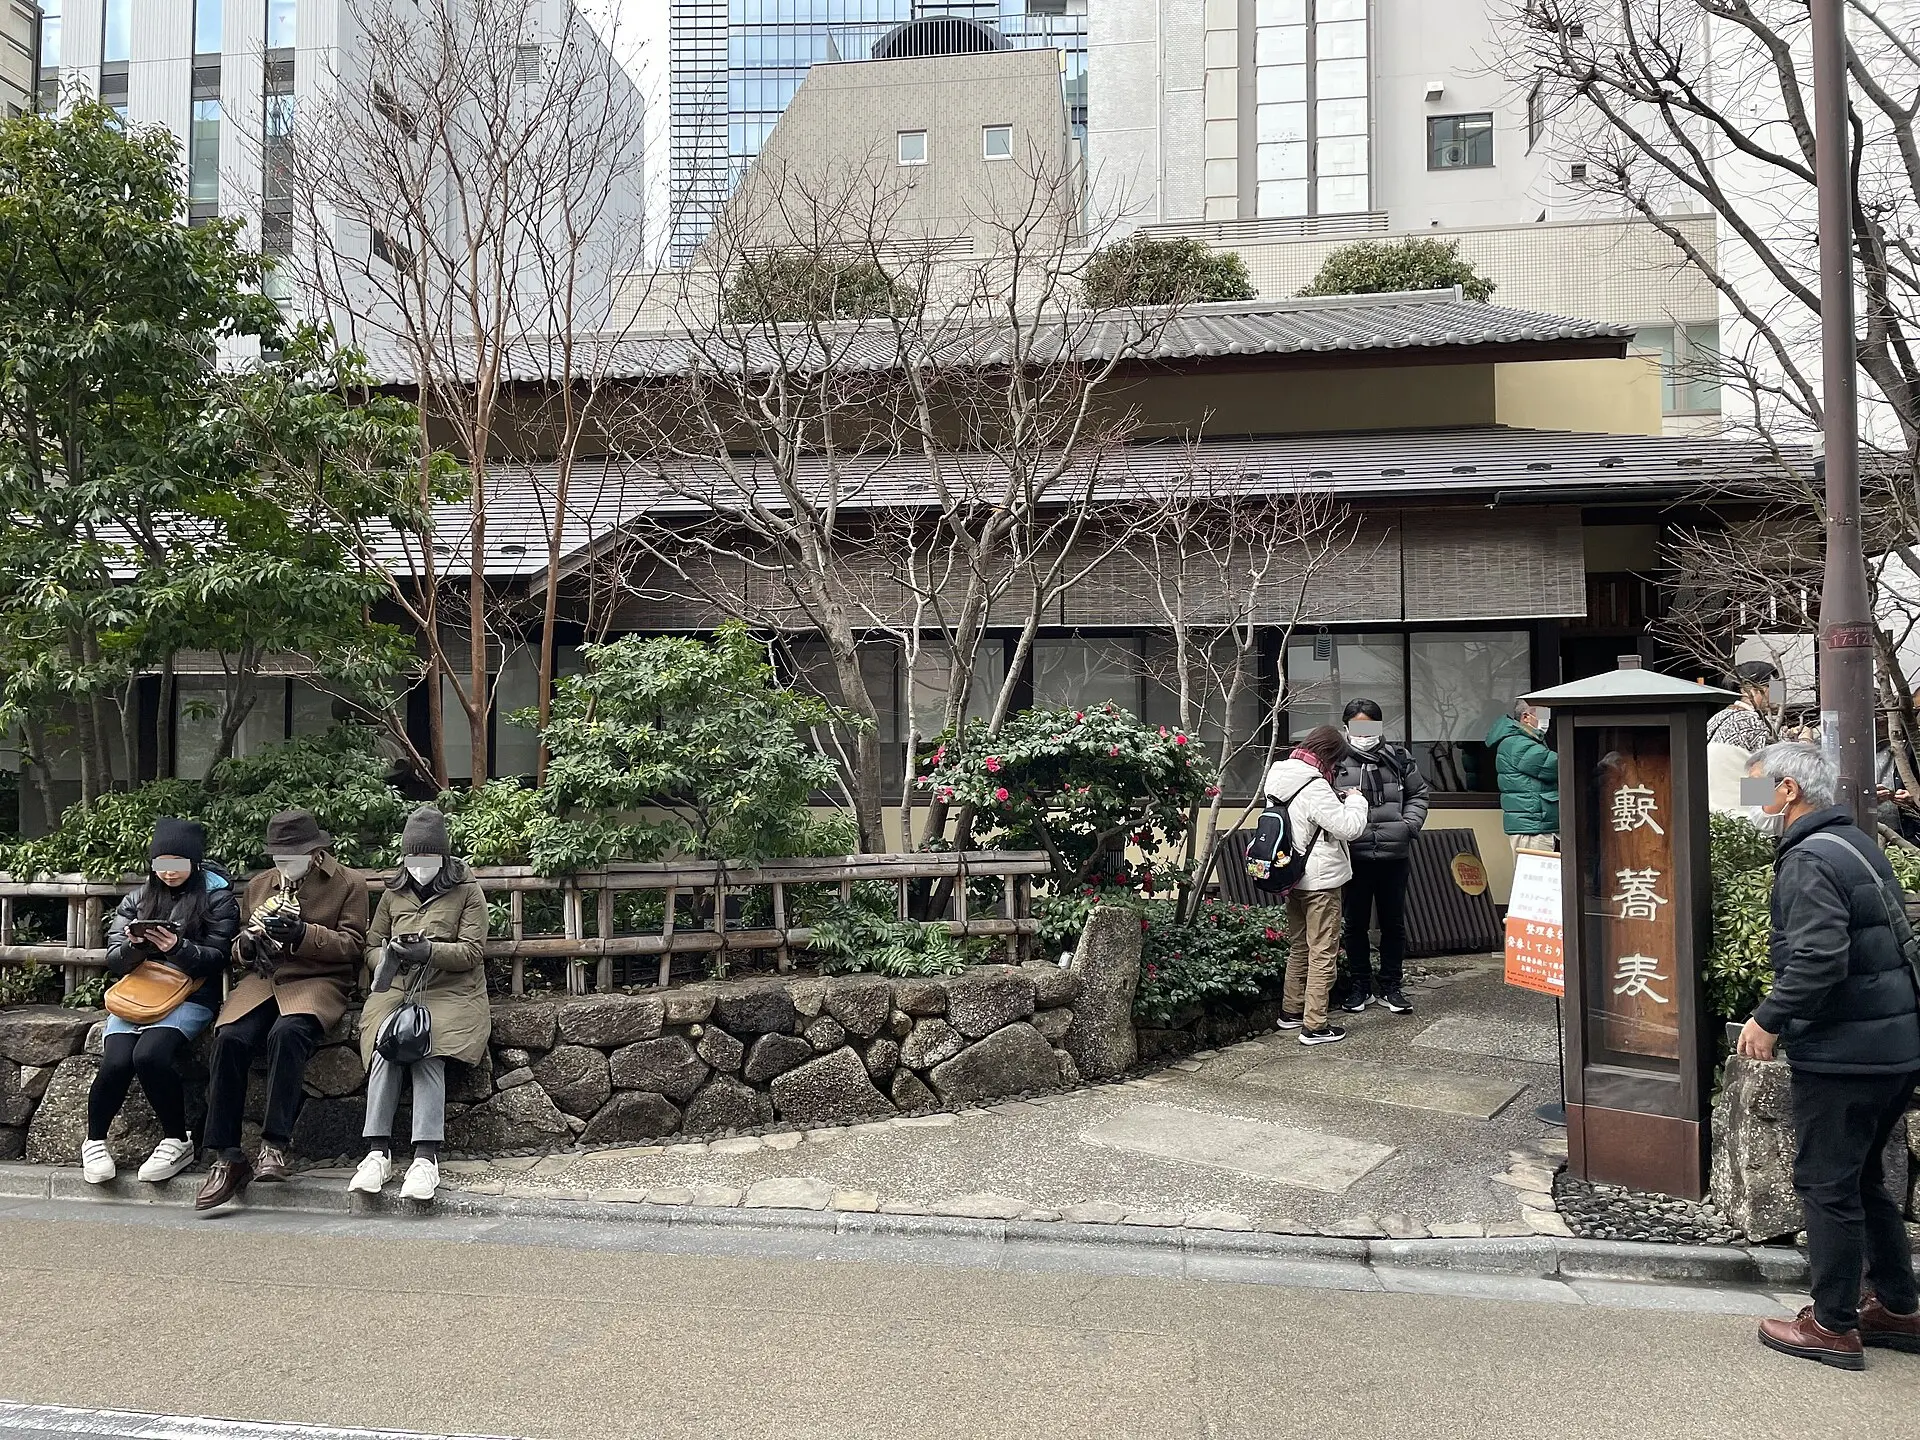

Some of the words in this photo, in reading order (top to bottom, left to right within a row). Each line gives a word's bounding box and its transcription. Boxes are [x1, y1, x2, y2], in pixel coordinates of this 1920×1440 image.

[1831, 633, 1869, 646] 17-12
[1610, 783, 1669, 1004] 藪蕎麦
